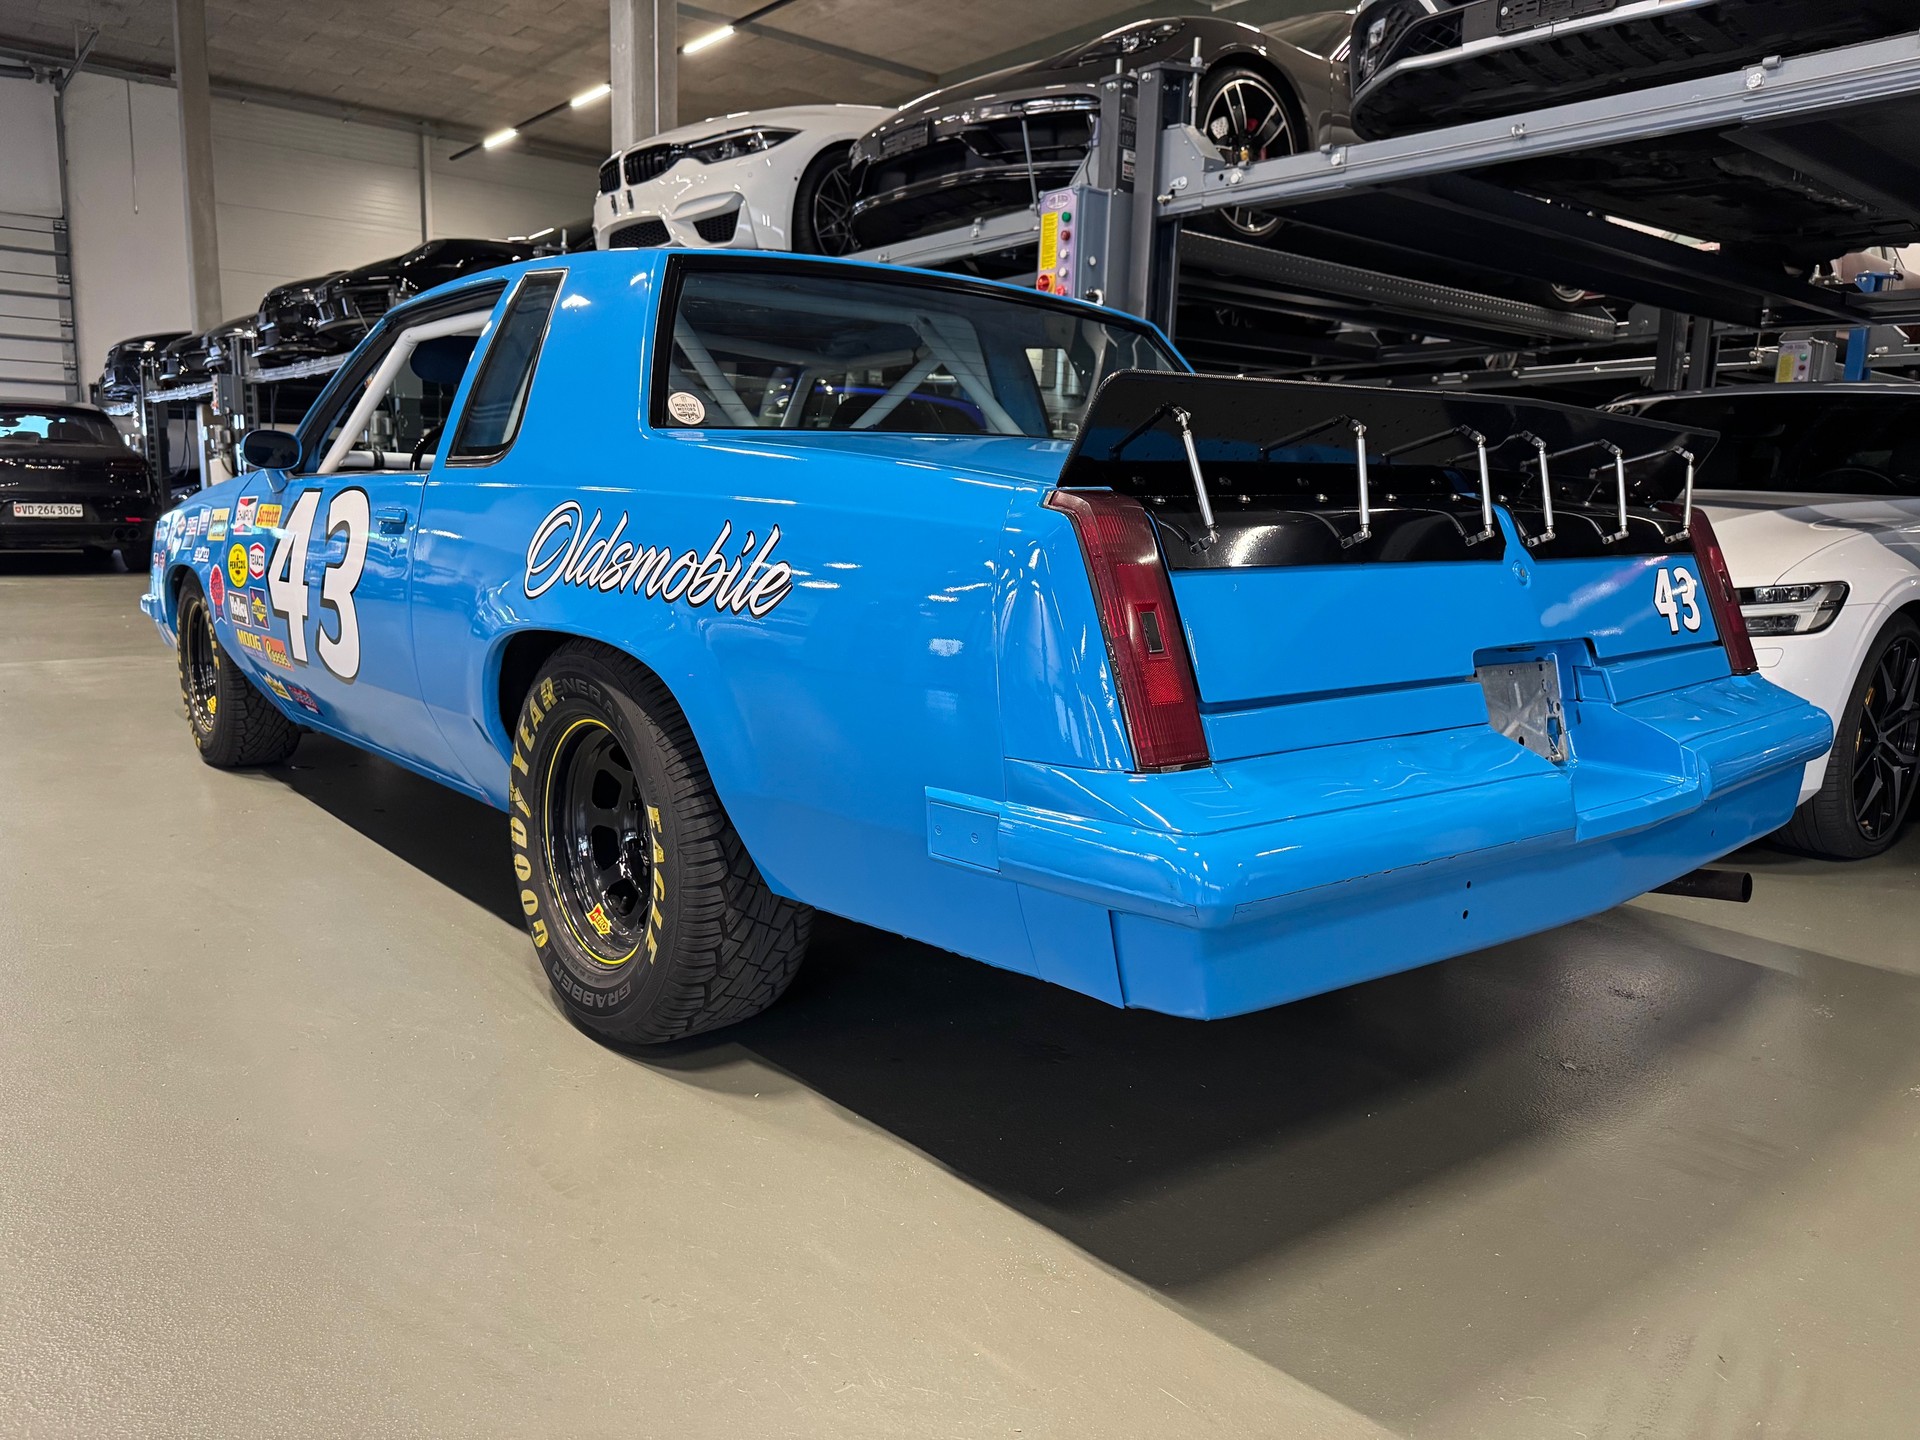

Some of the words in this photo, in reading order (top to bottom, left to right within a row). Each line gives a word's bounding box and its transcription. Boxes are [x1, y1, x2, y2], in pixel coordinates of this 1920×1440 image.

[250, 554, 264, 567] TEXACO
[267, 486, 371, 684] 43
[524, 500, 793, 619] Oldsmobile
[1653, 565, 1701, 635] 43
[236, 629, 262, 651] MOOG
[510, 676, 559, 948] GOODYEAR
[646, 804, 666, 965] EAGLE
[592, 911, 608, 930] AERO
[551, 960, 632, 1009] GRABBER
